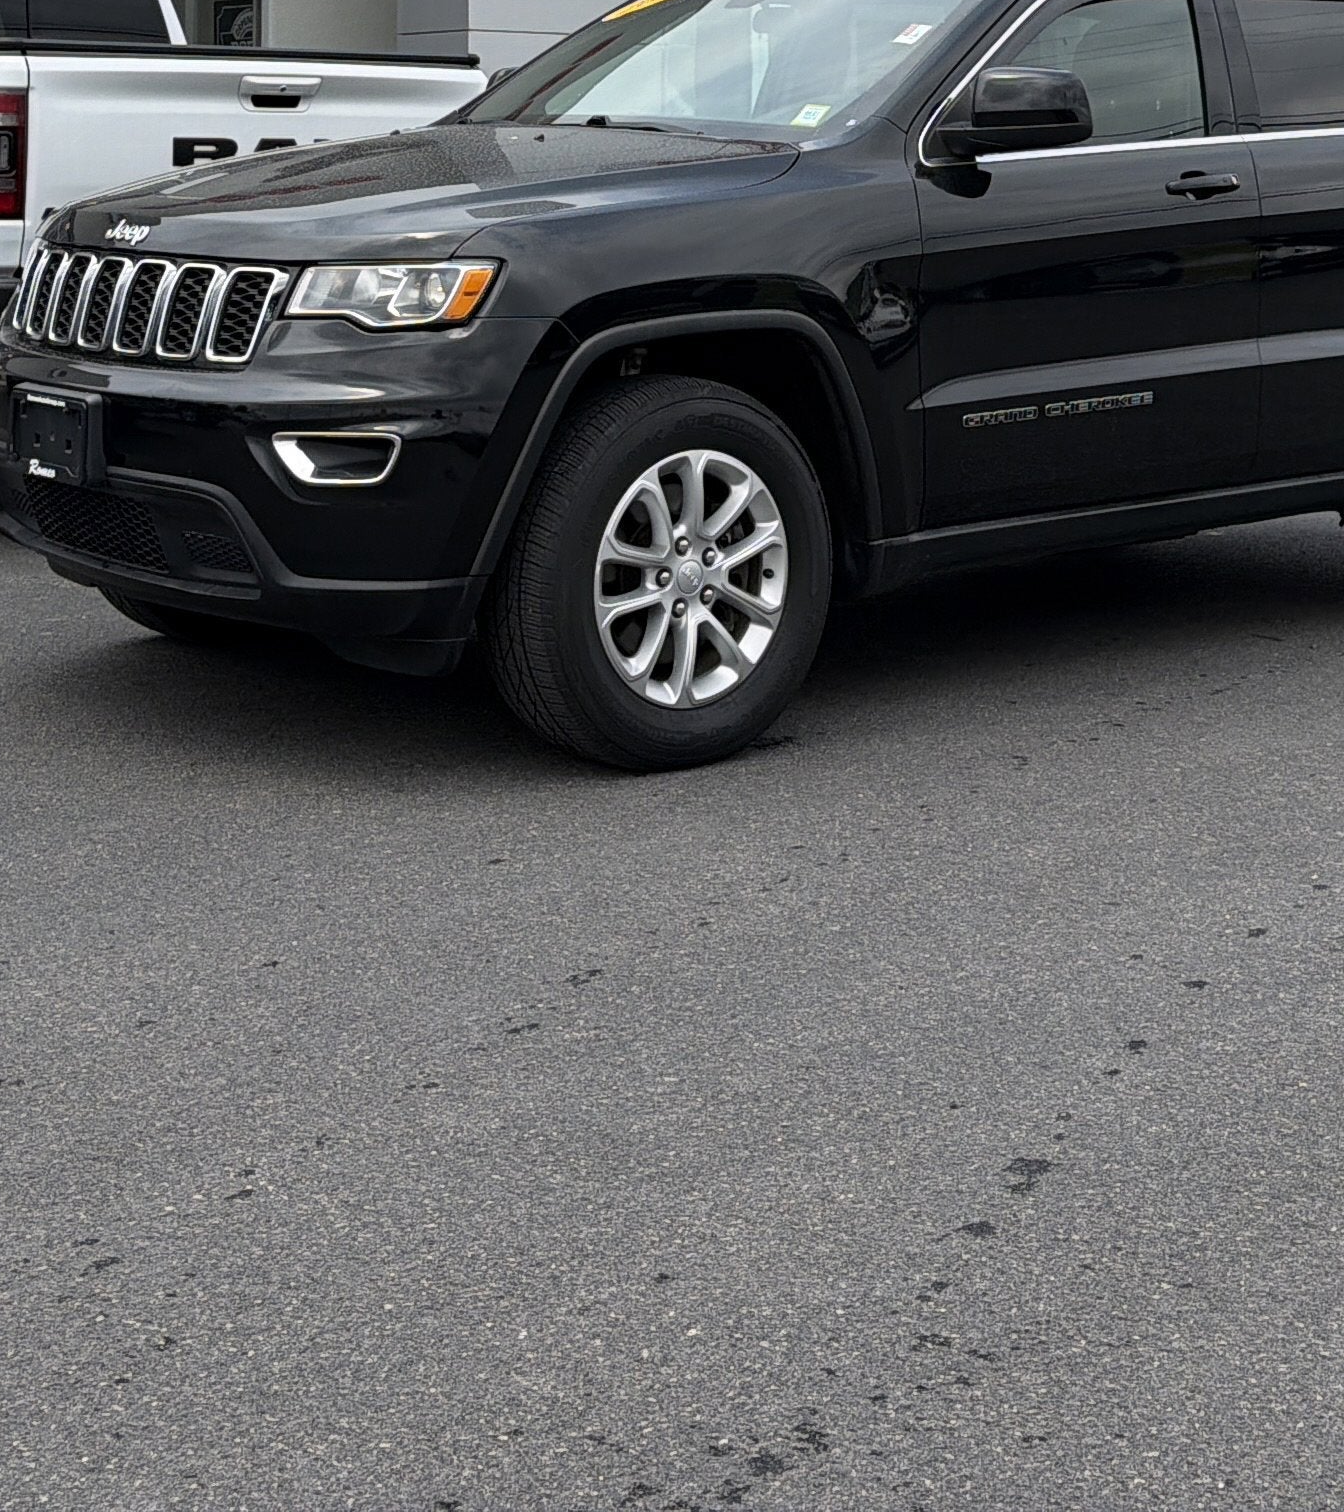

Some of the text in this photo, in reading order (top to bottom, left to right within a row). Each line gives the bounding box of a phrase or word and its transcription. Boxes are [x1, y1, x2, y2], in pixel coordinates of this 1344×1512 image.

[104, 218, 151, 246] Jeep
[962, 391, 1154, 428] GRAND CHEROKEE
